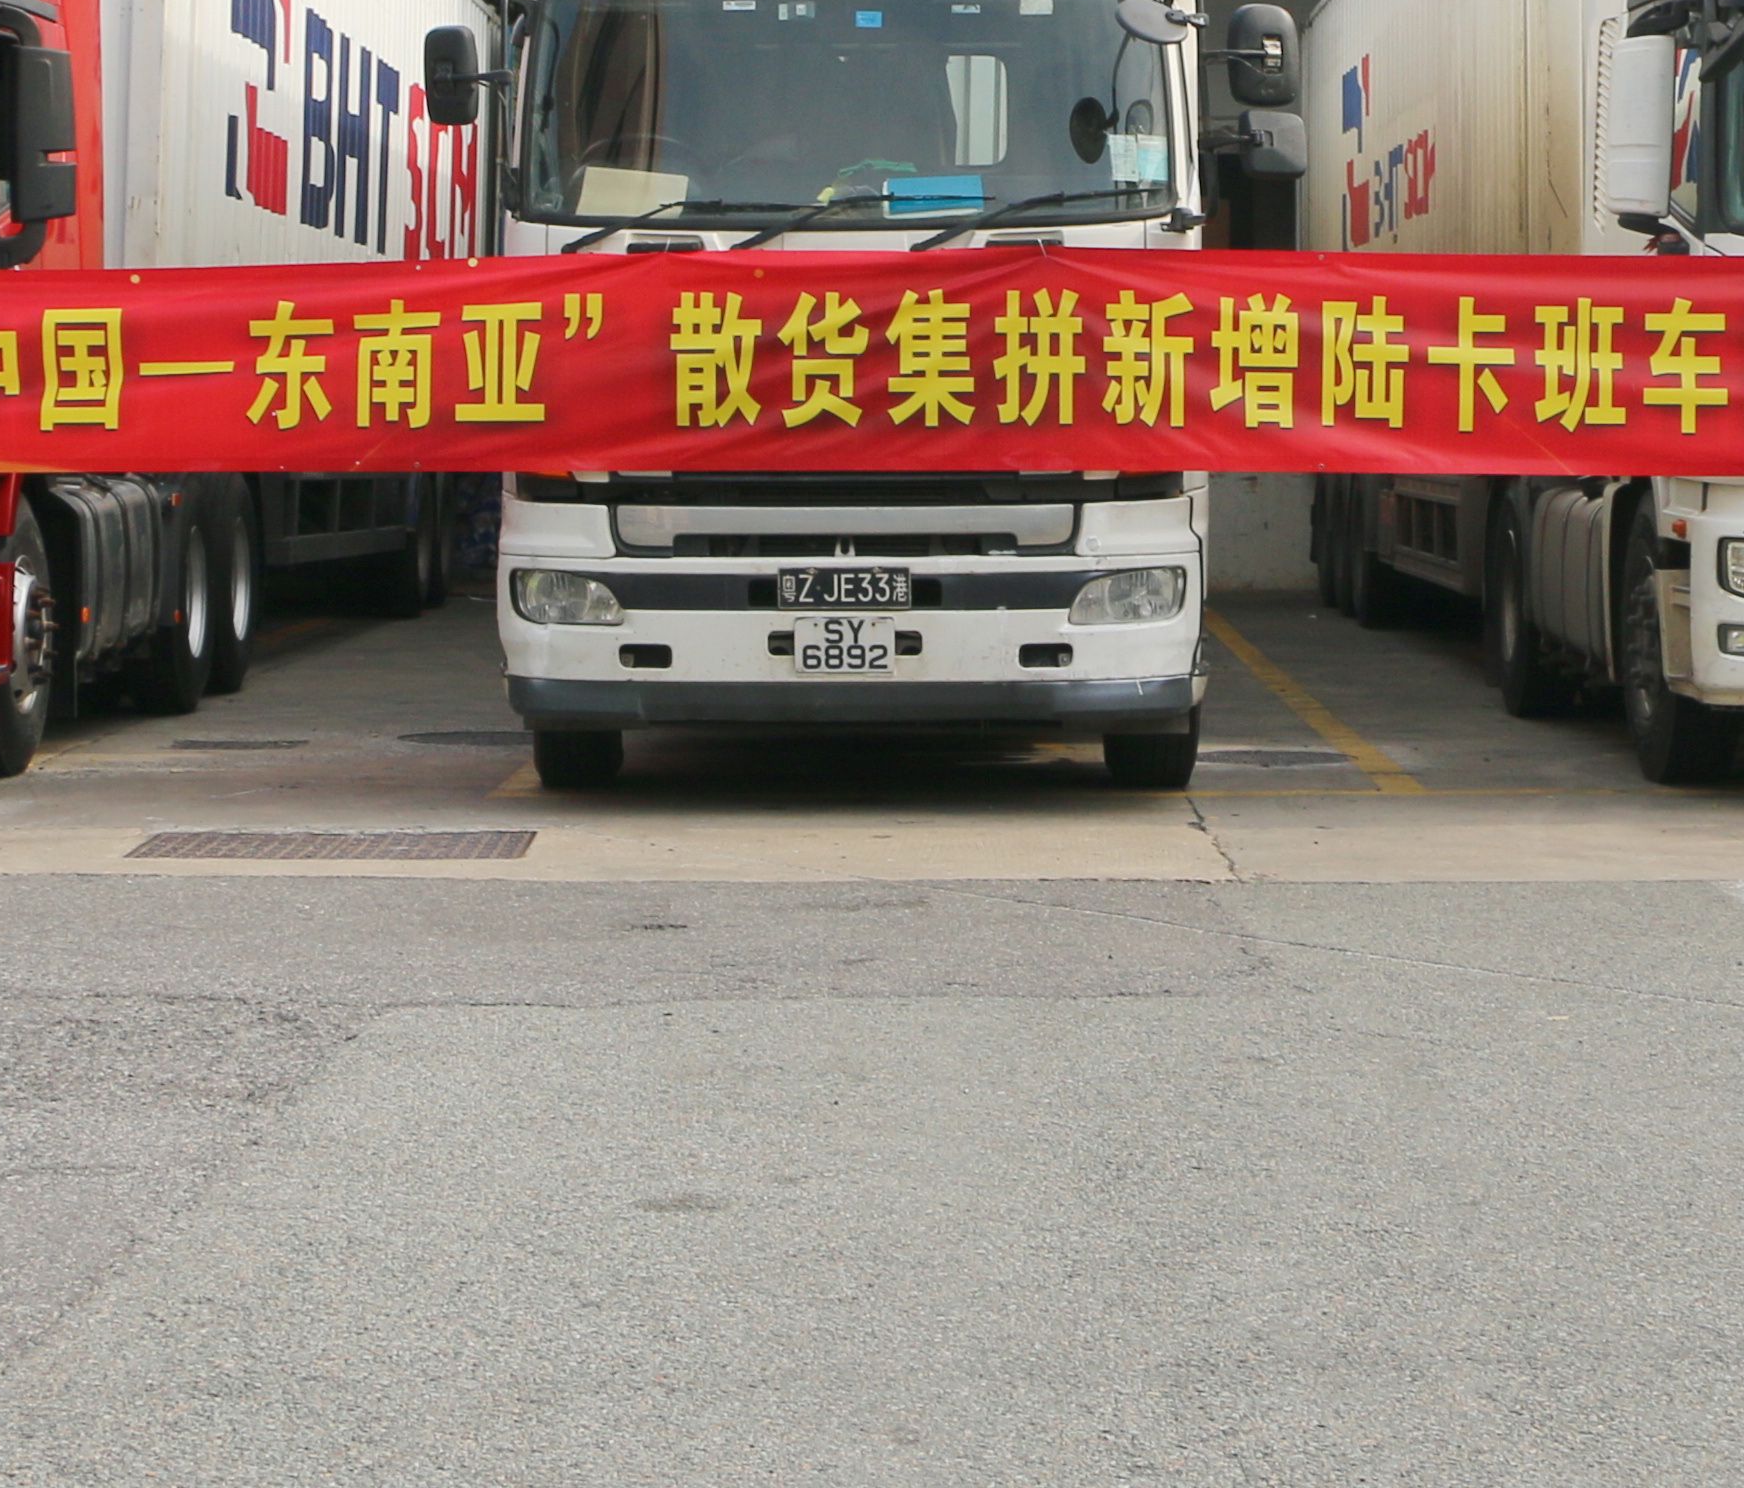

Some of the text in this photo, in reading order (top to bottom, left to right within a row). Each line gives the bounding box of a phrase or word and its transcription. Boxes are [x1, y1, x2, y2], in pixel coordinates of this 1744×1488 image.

[300, 7, 399, 254] BHT
[824, 620, 865, 644] SY
[802, 644, 889, 670] 6892
